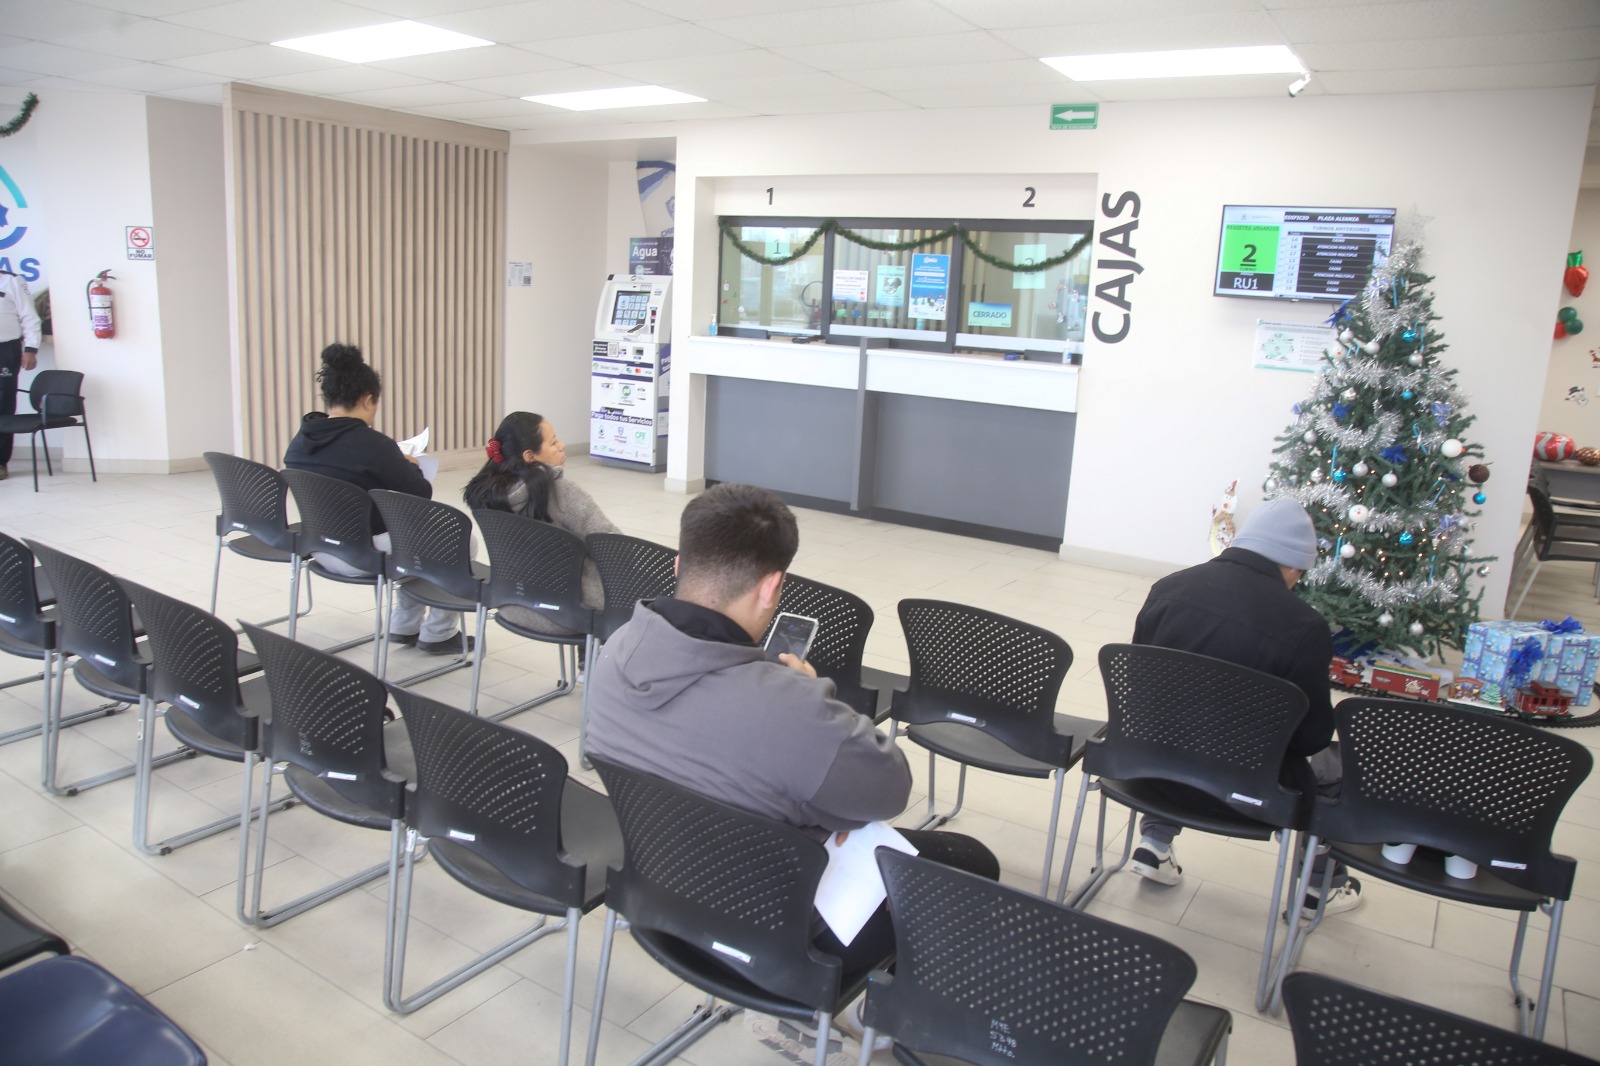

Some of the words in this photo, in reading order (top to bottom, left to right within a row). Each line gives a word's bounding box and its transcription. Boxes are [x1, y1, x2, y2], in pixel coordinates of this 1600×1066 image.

[766, 187, 774, 205] 1
[1022, 187, 1036, 208] 2
[632, 246, 658, 260] Agua
[773, 239, 781, 255] 1
[1242, 244, 1257, 262] 2
[1092, 190, 1145, 344] CAJAS
[1233, 277, 1258, 290] RU1
[973, 311, 1007, 319] CERRADO
[604, 413, 619, 421] todos
[628, 416, 653, 425] Servicios
[635, 431, 646, 439] CFE
